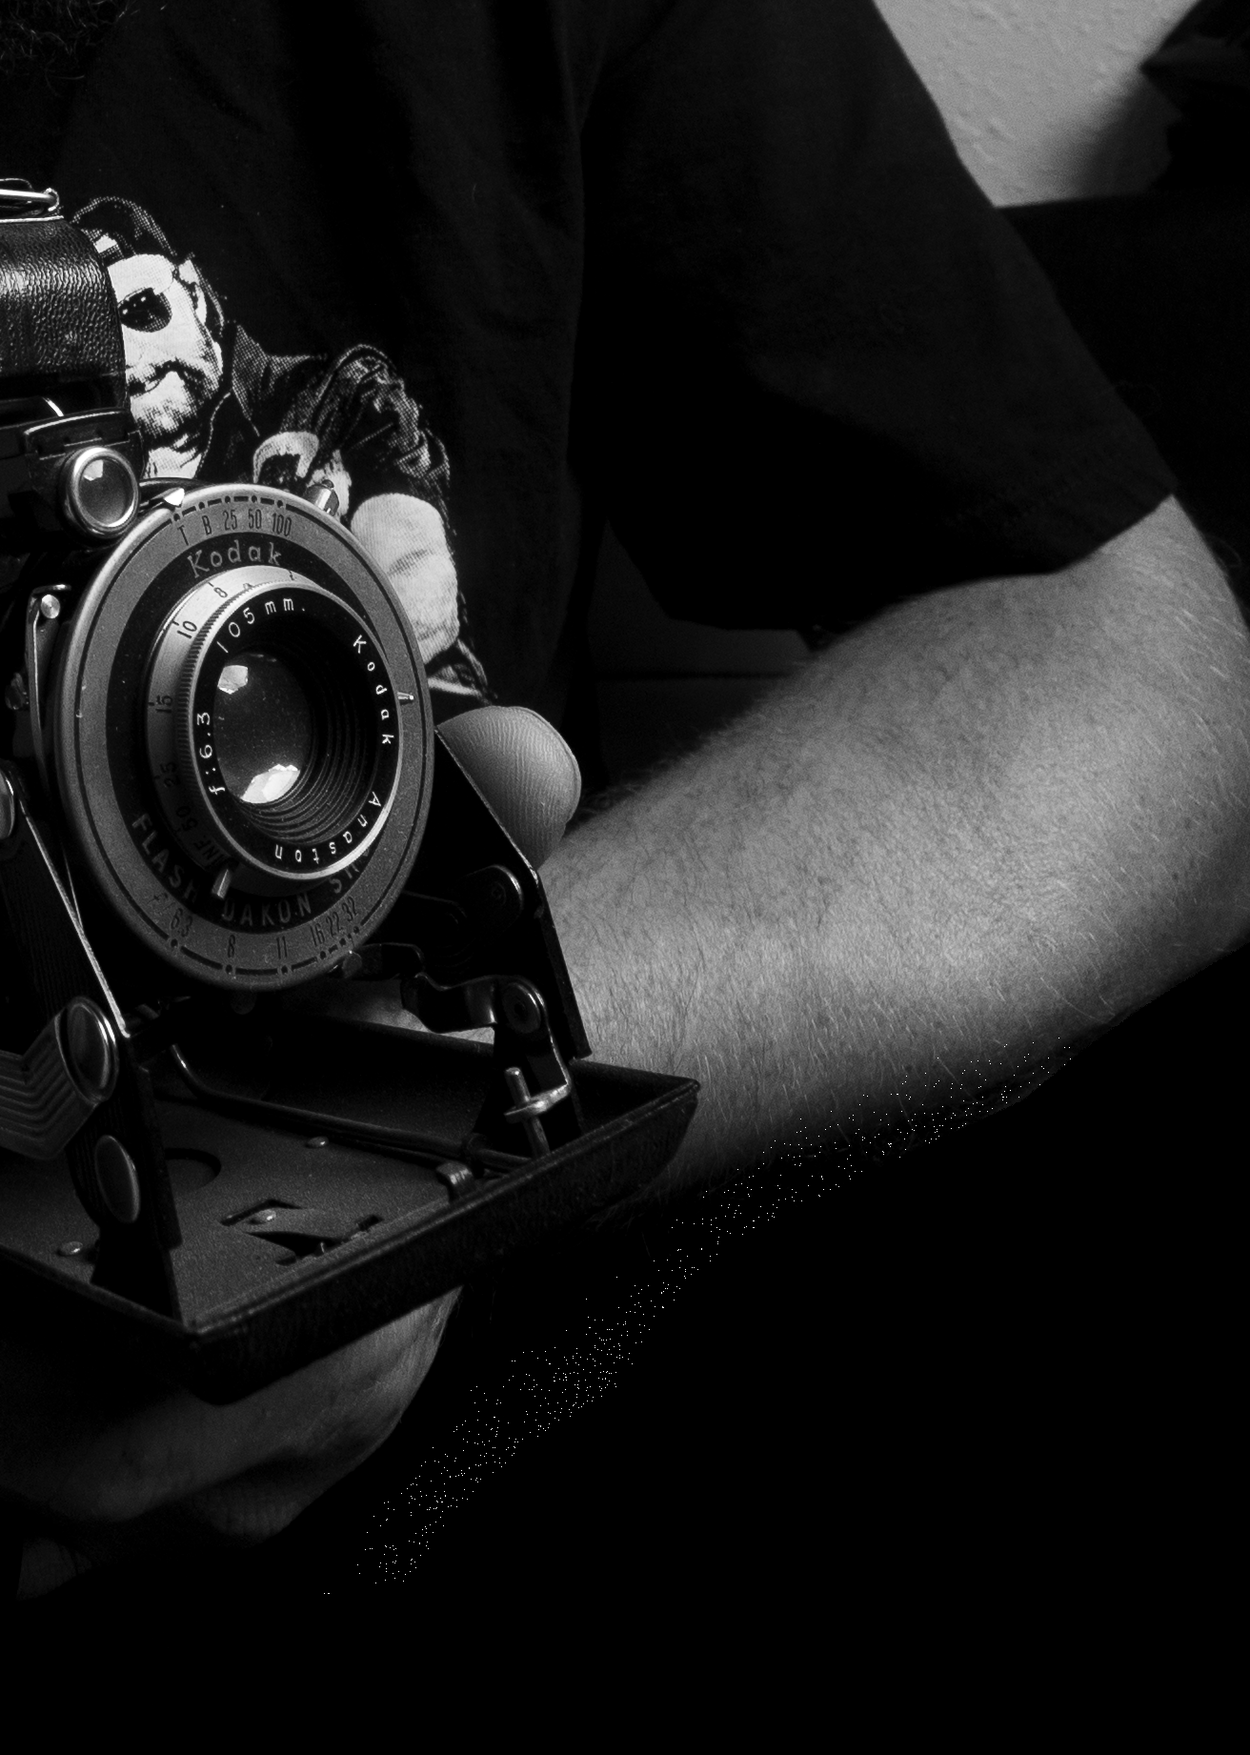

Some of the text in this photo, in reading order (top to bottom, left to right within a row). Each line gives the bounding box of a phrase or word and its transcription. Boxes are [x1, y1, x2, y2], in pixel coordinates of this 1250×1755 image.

[177, 508, 292, 545] T B 25 50 100
[186, 539, 283, 579] Kodak
[176, 620, 198, 640] 10
[154, 695, 173, 714] 15
[352, 634, 395, 745] Kodak
[175, 805, 198, 832] 50
[274, 791, 382, 865] Anaston
[131, 812, 201, 905] FLASH
[227, 934, 236, 958] 8
[276, 935, 287, 960] 11
[310, 922, 325, 947] 16
[325, 911, 344, 937] 22
[342, 896, 358, 922] 32
